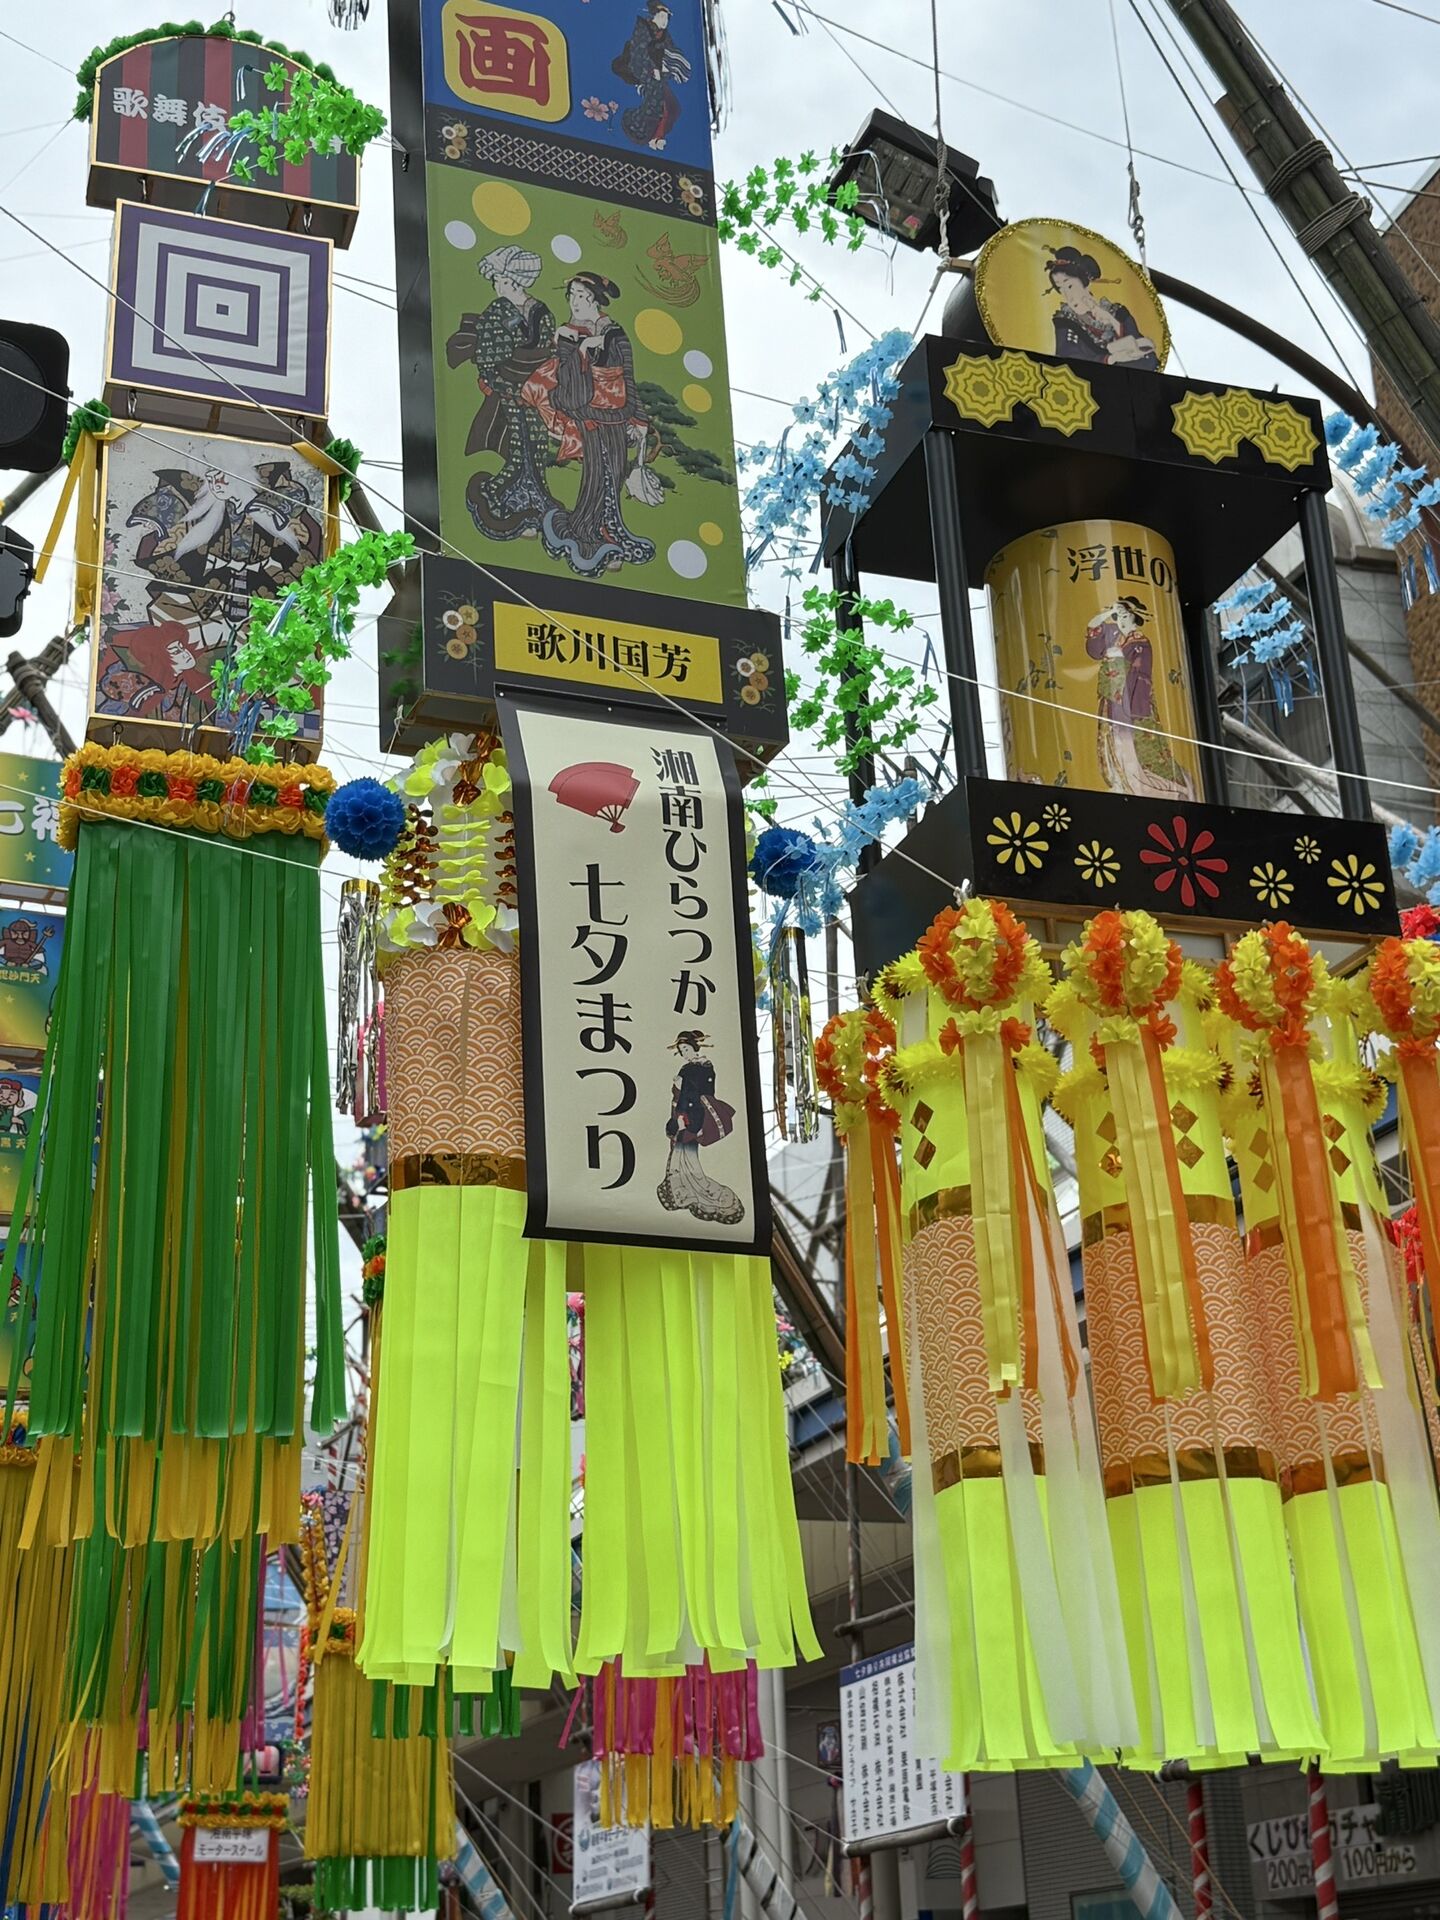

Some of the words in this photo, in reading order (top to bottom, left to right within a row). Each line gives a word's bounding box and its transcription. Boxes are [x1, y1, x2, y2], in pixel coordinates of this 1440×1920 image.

[455, 13, 551, 106] 画
[1066, 543, 1174, 594] 浮世の
[526, 622, 692, 683] 歌川国芳
[650, 746, 717, 1017] 湘南ひらつか
[568, 863, 638, 1190] 七夕まつり
[199, 1843, 265, 1858] モータースクール
[1343, 1847, 1417, 1878] 100円から
